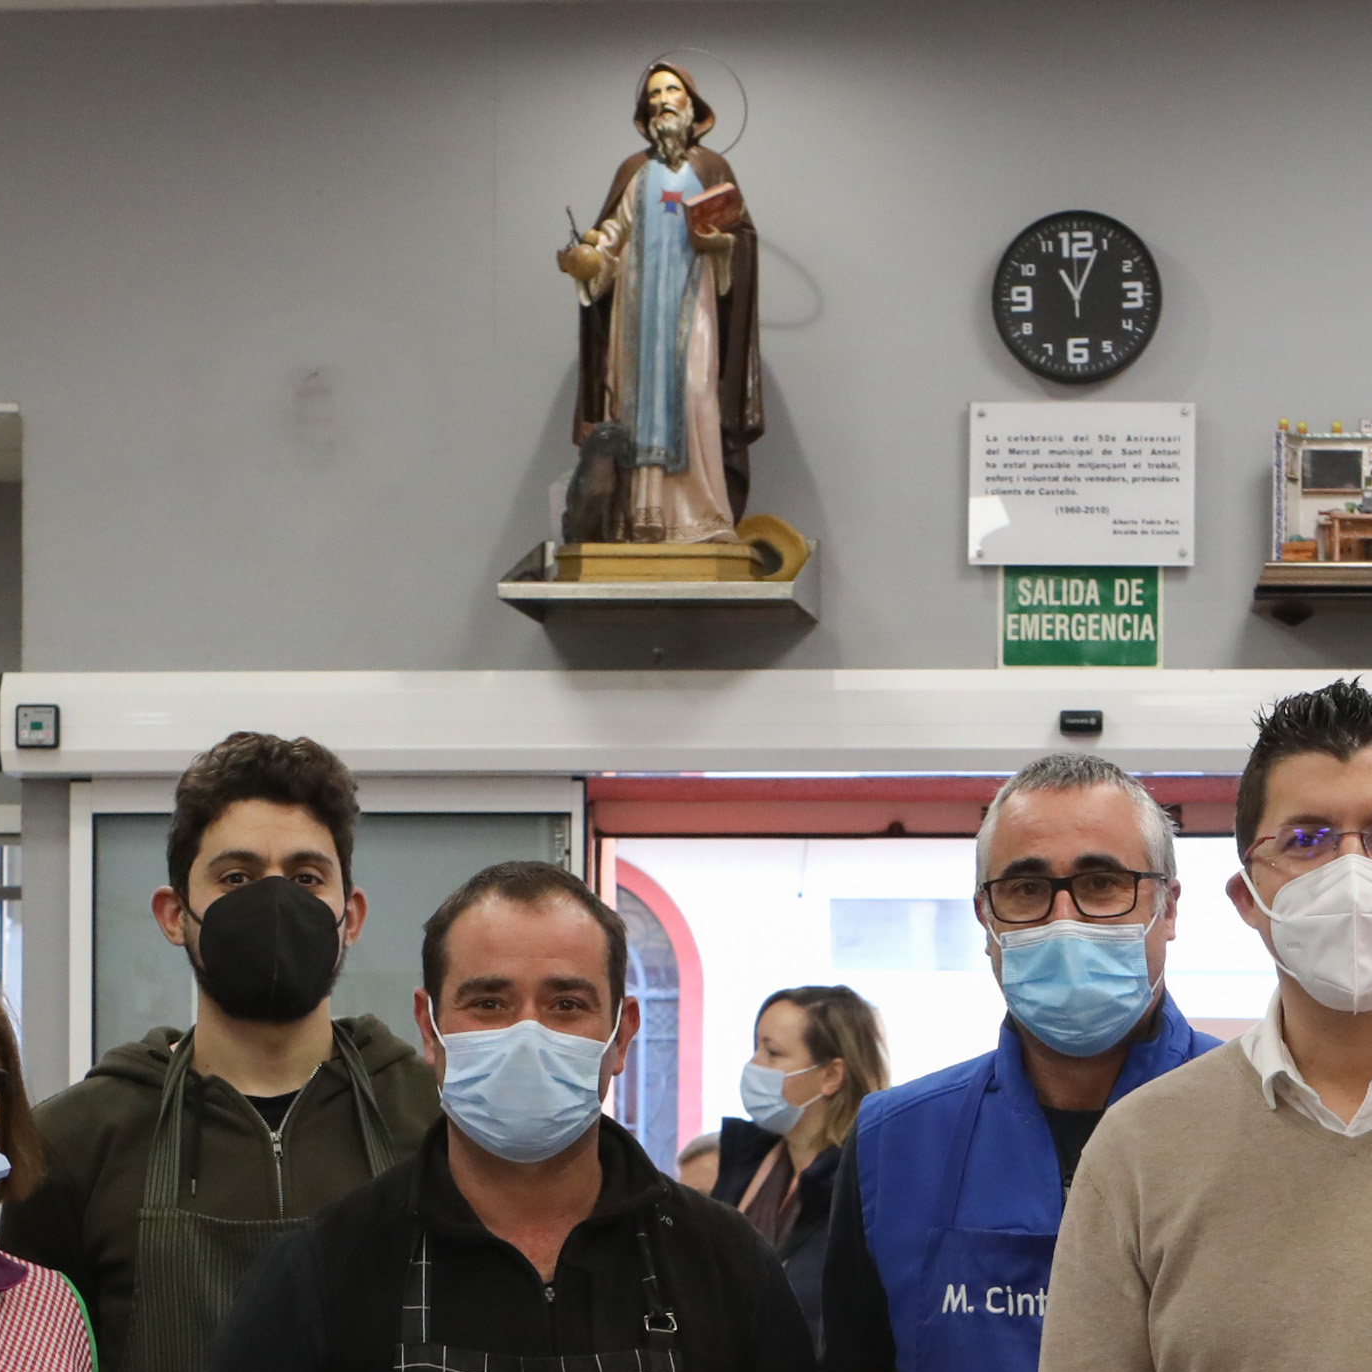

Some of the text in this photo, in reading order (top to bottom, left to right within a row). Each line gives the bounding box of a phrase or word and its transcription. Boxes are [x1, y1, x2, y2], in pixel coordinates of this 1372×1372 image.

[1041, 240, 1054, 253] 11
[1058, 231, 1094, 258] 12
[1101, 238, 1108, 251] 1
[1021, 263, 1036, 277] 10
[1121, 260, 1133, 273] 2
[1011, 286, 1033, 312] 9
[1122, 281, 1145, 309] 3
[1022, 322, 1033, 335] 8
[1121, 319, 1133, 331] 4
[1042, 342, 1053, 356] 7
[1066, 337, 1090, 364] 6
[1101, 340, 1114, 353] 5
[985, 434, 999, 443] La
[1072, 434, 1090, 443] del
[1125, 434, 1182, 443] Aniversari
[985, 447, 1181, 458] del Mercat municipal de Sant Antoni
[985, 461, 998, 470] ha
[1002, 461, 1027, 470] estat
[1032, 461, 1071, 471] possible
[1022, 474, 1061, 483] voluntat
[1062, 474, 1082, 483] dels
[990, 487, 1023, 496] clients
[1024, 487, 1037, 496] de
[1054, 504, 1111, 516] (1960-2010)
[1017, 576, 1145, 607] SALIDA DE
[1005, 612, 1156, 642] EMERGENCIA
[941, 1283, 975, 1314] M.
